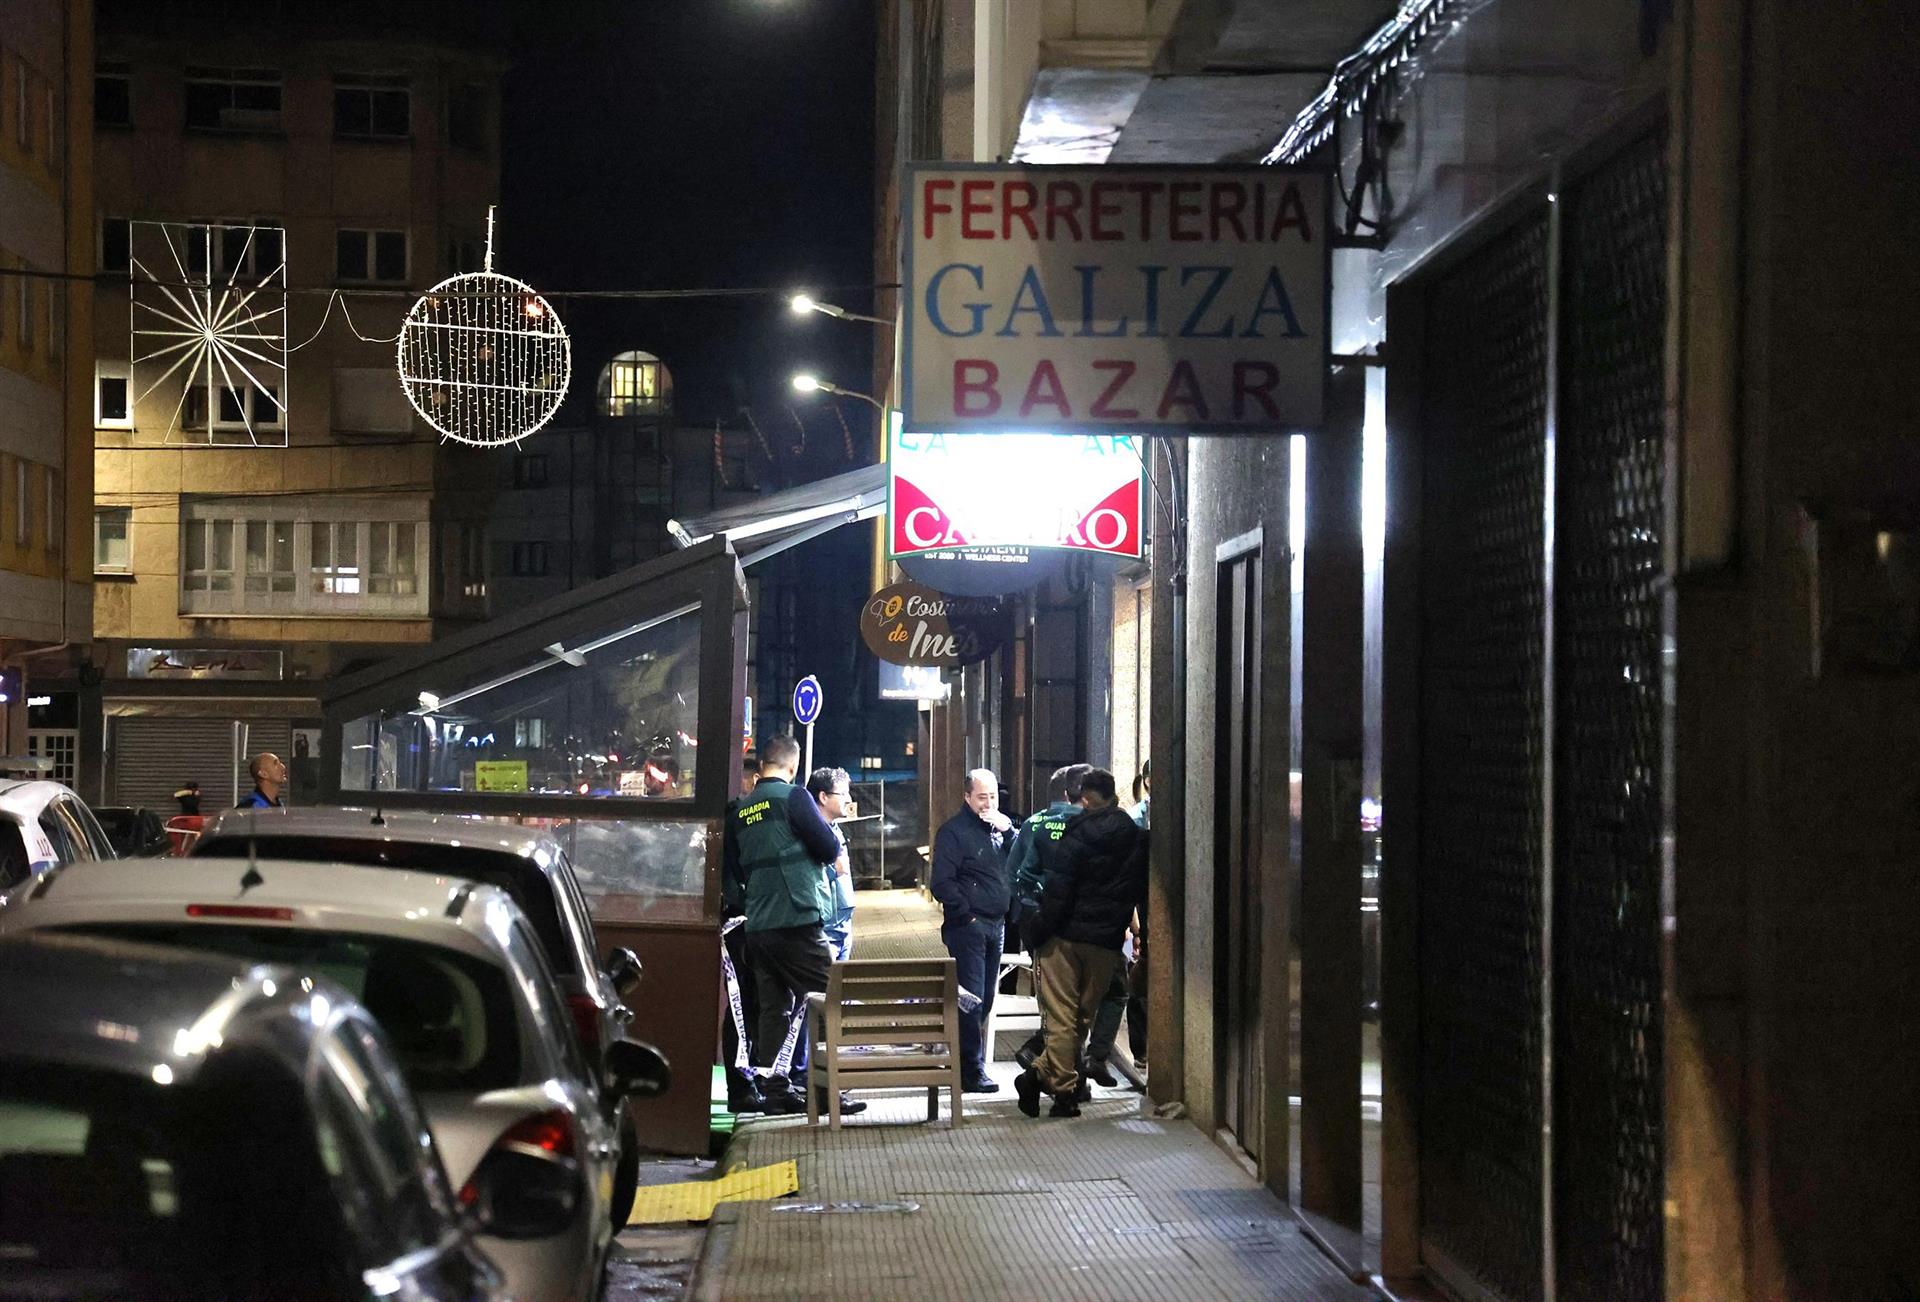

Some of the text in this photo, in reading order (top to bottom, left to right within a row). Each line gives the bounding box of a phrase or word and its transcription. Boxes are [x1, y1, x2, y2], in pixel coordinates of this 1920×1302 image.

[923, 180, 1312, 242] FERRETERIA
[924, 263, 1309, 338] GALIZA
[953, 359, 1281, 420] BAZAR
[887, 623, 908, 642] de
[738, 800, 770, 818] GUARDIA
[746, 812, 763, 825] CIVIL
